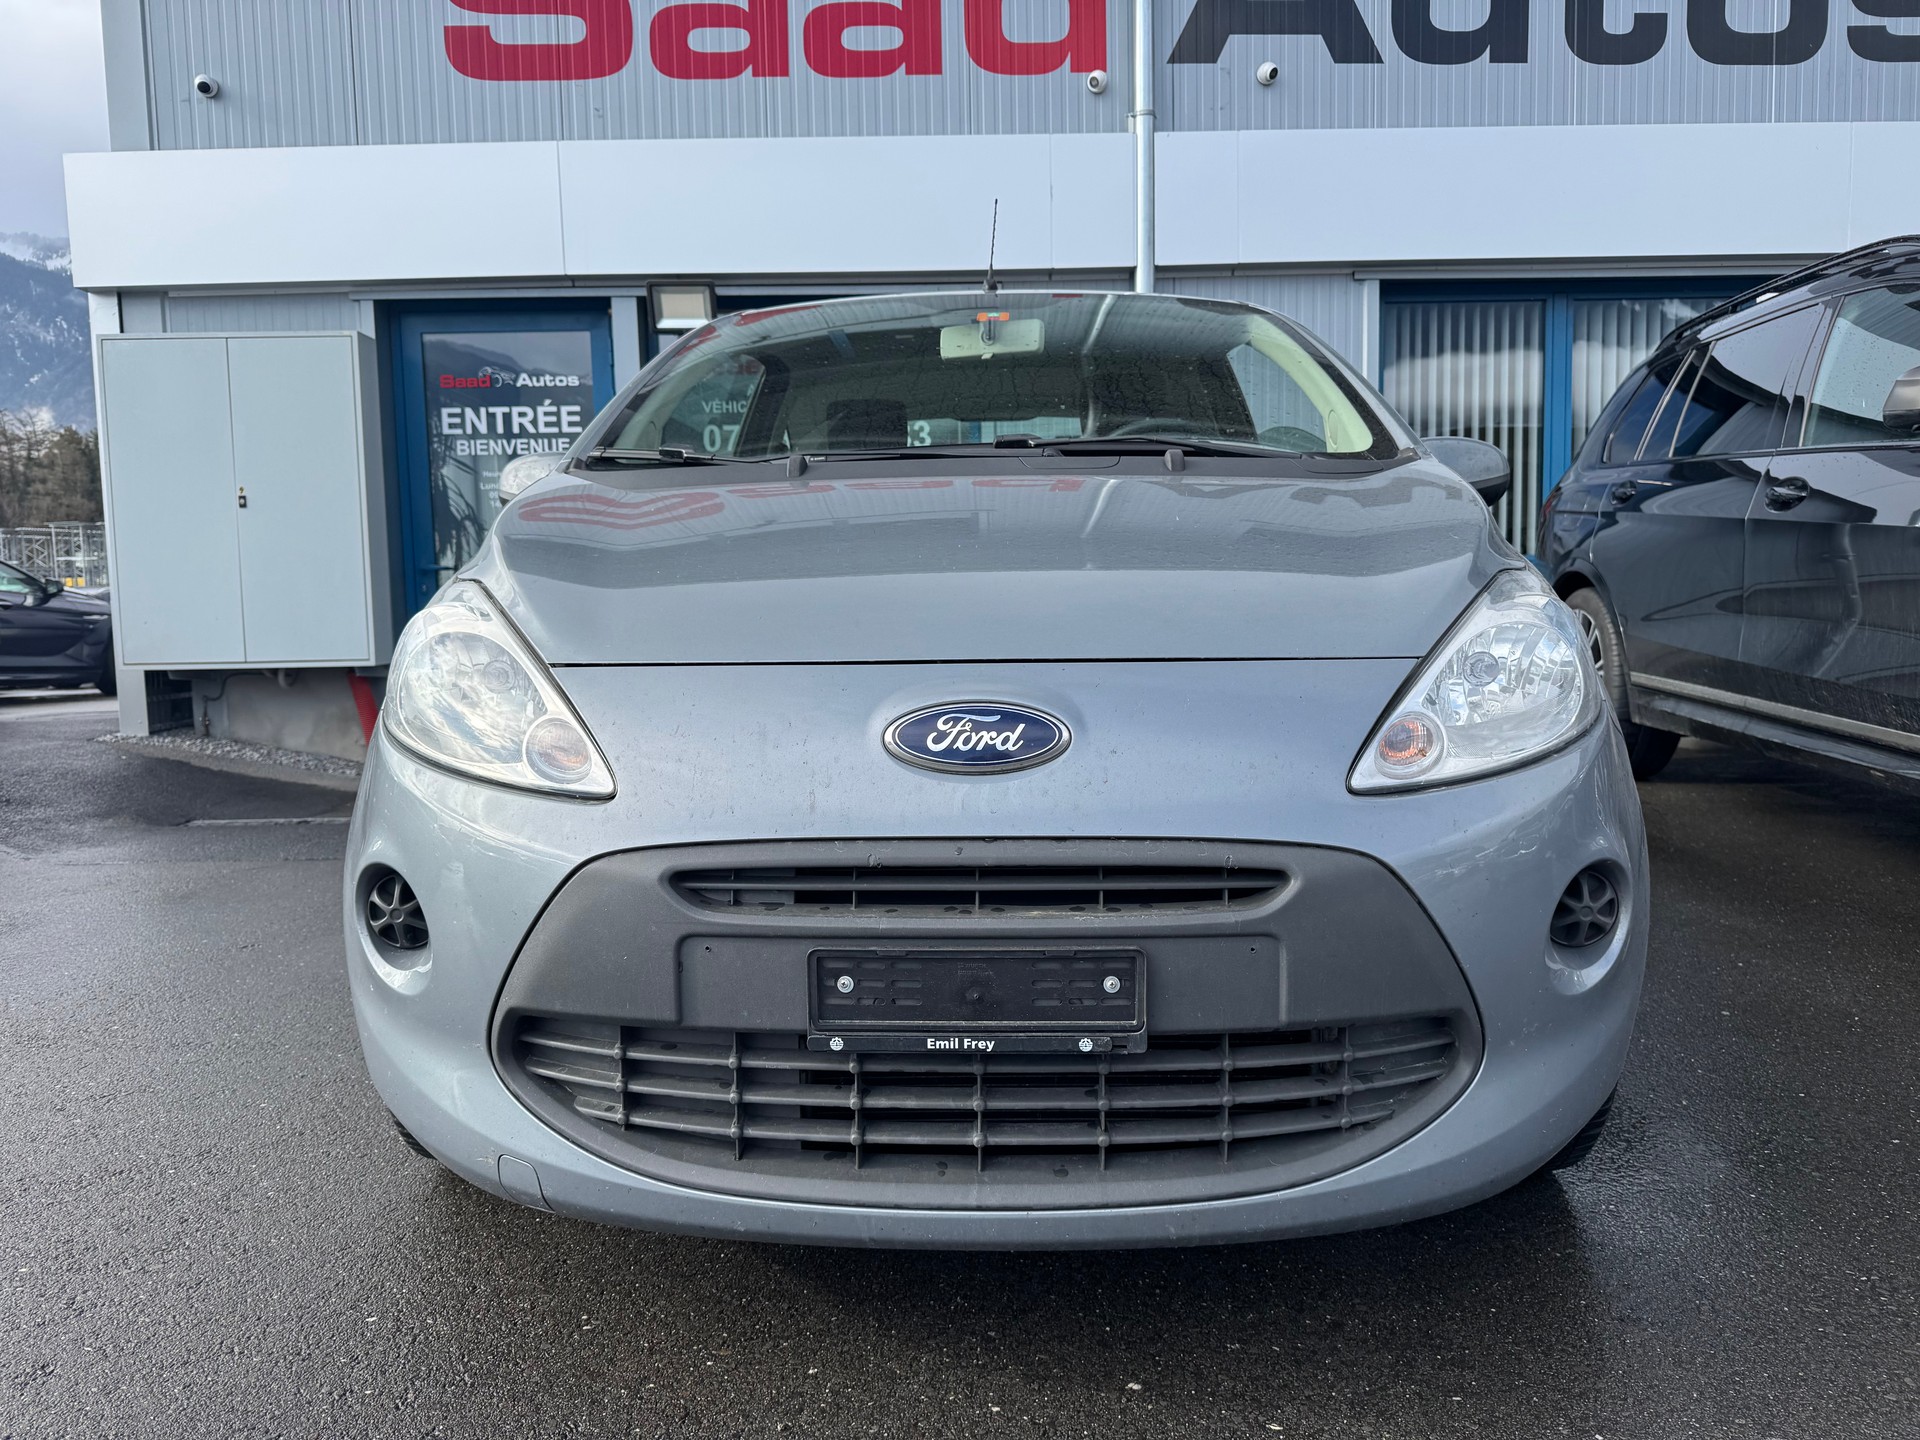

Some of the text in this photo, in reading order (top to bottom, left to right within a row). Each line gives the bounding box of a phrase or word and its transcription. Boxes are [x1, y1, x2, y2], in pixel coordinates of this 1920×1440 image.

[440, 373, 580, 388] Saad Autos
[441, 399, 583, 435] ENTRÉE
[456, 438, 570, 456] BIENVENUE
[926, 713, 1026, 752] Ford
[927, 1038, 995, 1052] Emil Frey
